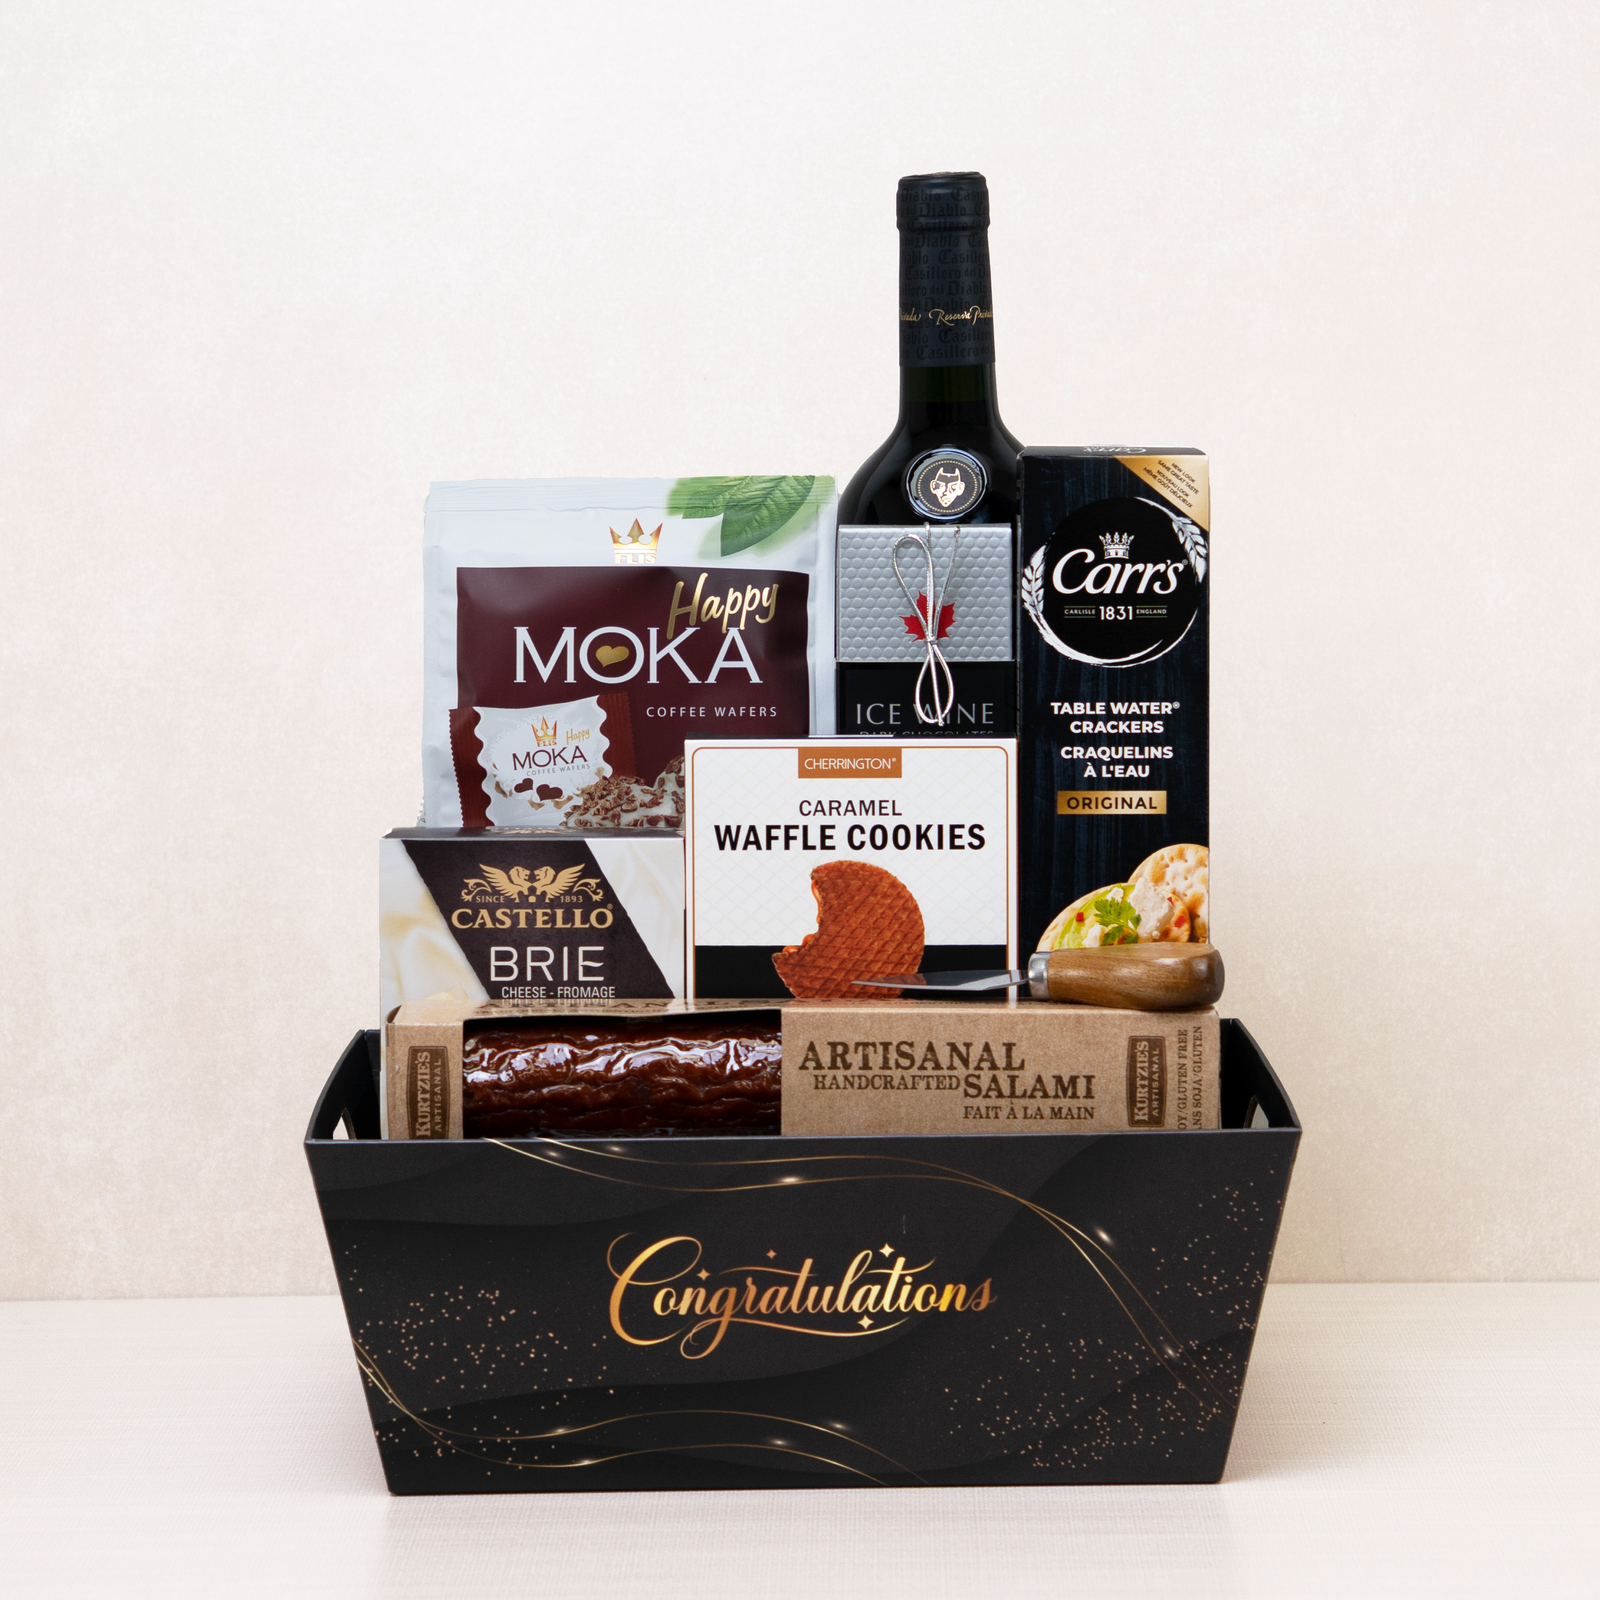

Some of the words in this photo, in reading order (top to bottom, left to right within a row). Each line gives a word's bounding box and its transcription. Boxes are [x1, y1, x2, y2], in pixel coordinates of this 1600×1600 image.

[919, 202, 966, 217] Diablo
[915, 232, 959, 247] Diablo
[905, 264, 961, 280] Casillero
[930, 284, 944, 294] del
[948, 280, 987, 295] Diablo
[928, 308, 972, 326] Reserva
[916, 345, 979, 361] Casillero
[1157, 459, 1171, 472] SAME
[1170, 470, 1185, 484] GREAT
[1185, 481, 1199, 495] TASTE
[1171, 462, 1183, 473] NEW
[1182, 471, 1197, 484] LOOK
[1156, 469, 1178, 489] NOUVEAU
[1177, 486, 1190, 498] LOOK
[614, 553, 657, 564] FLIS
[666, 572, 780, 640] Happy
[1099, 605, 1133, 620] 1831
[513, 625, 763, 684] MOKA
[646, 706, 706, 717] COFFEE
[714, 706, 777, 717] WAFERS
[856, 703, 902, 725] ICE
[913, 703, 994, 724] WINE
[1050, 702, 1106, 715] TABLE
[566, 727, 590, 745] Happy
[1070, 721, 1164, 734] CRACKERS
[512, 745, 588, 771] MOKA
[1060, 746, 1174, 761] CRAQUELINS
[526, 767, 557, 777] COFFEE
[559, 763, 591, 773] WAFERS
[1083, 762, 1097, 777] À
[1101, 765, 1150, 778] L'EAU
[799, 799, 902, 816] CARAMEL
[1066, 796, 1158, 810] ORIGINAL
[714, 824, 836, 851] WAFFLE
[847, 823, 986, 851] COOKIES
[476, 895, 505, 903] SINCE
[560, 895, 583, 903] 1893
[490, 946, 604, 982] BRIE
[501, 986, 547, 998] CHEESE
[557, 986, 616, 998] FROMAGE
[1177, 1029, 1188, 1060] FREE
[798, 1040, 1026, 1071] ARTISANAL
[1193, 1026, 1203, 1109] SOJA/GLUTEN
[812, 1073, 961, 1090] HANDCRAFTED
[963, 1073, 1096, 1099] SALAMI
[1134, 1041, 1149, 1121] KURTZIE'S
[415, 1051, 431, 1137] KURTZIE'S
[434, 1058, 442, 1132] ARTISANAL
[1177, 1062, 1188, 1130] OY/GLUTEN
[963, 1105, 1003, 1120] FAIT
[1006, 1100, 1019, 1120] À
[1023, 1106, 1046, 1120] LA
[1049, 1106, 1095, 1120] MAIN
[607, 1232, 998, 1360] Congratulations
